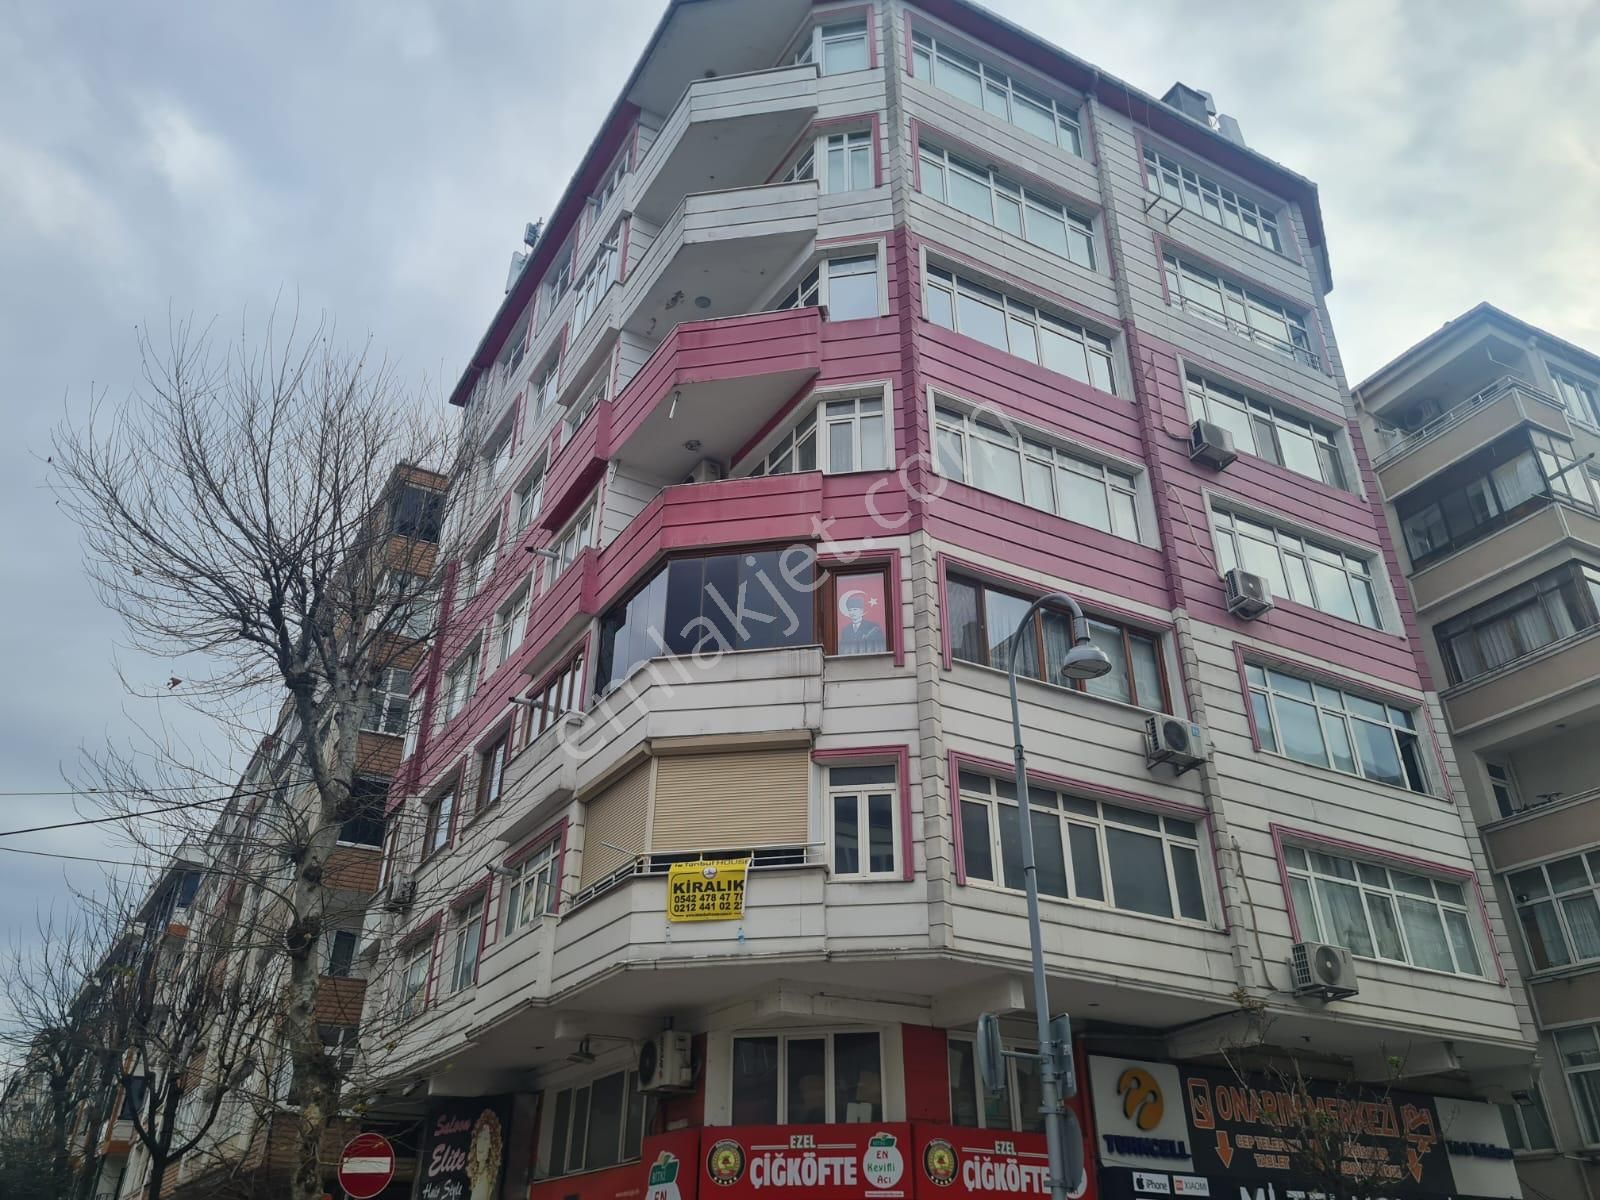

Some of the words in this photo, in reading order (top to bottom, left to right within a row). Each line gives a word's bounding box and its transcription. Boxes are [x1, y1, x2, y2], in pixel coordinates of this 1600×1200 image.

[673, 880, 745, 894] KİRALIK
[674, 894, 697, 904] 0542
[699, 893, 717, 902] 478
[719, 892, 731, 901] 47
[674, 903, 697, 913] 0212
[699, 902, 716, 911] 441
[719, 902, 731, 910] 02
[790, 1134, 816, 1149] EZEL
[994, 1140, 1016, 1155] EZEL
[429, 1144, 465, 1176] Elite
[876, 1150, 888, 1159] EN
[749, 1151, 858, 1189] ÇİĞKÖFTE
[962, 1155, 1052, 1194] ÇİĞKÖFTE
[1146, 1179, 1168, 1190] iPhone
[1184, 1182, 1208, 1191] XIAOMI
